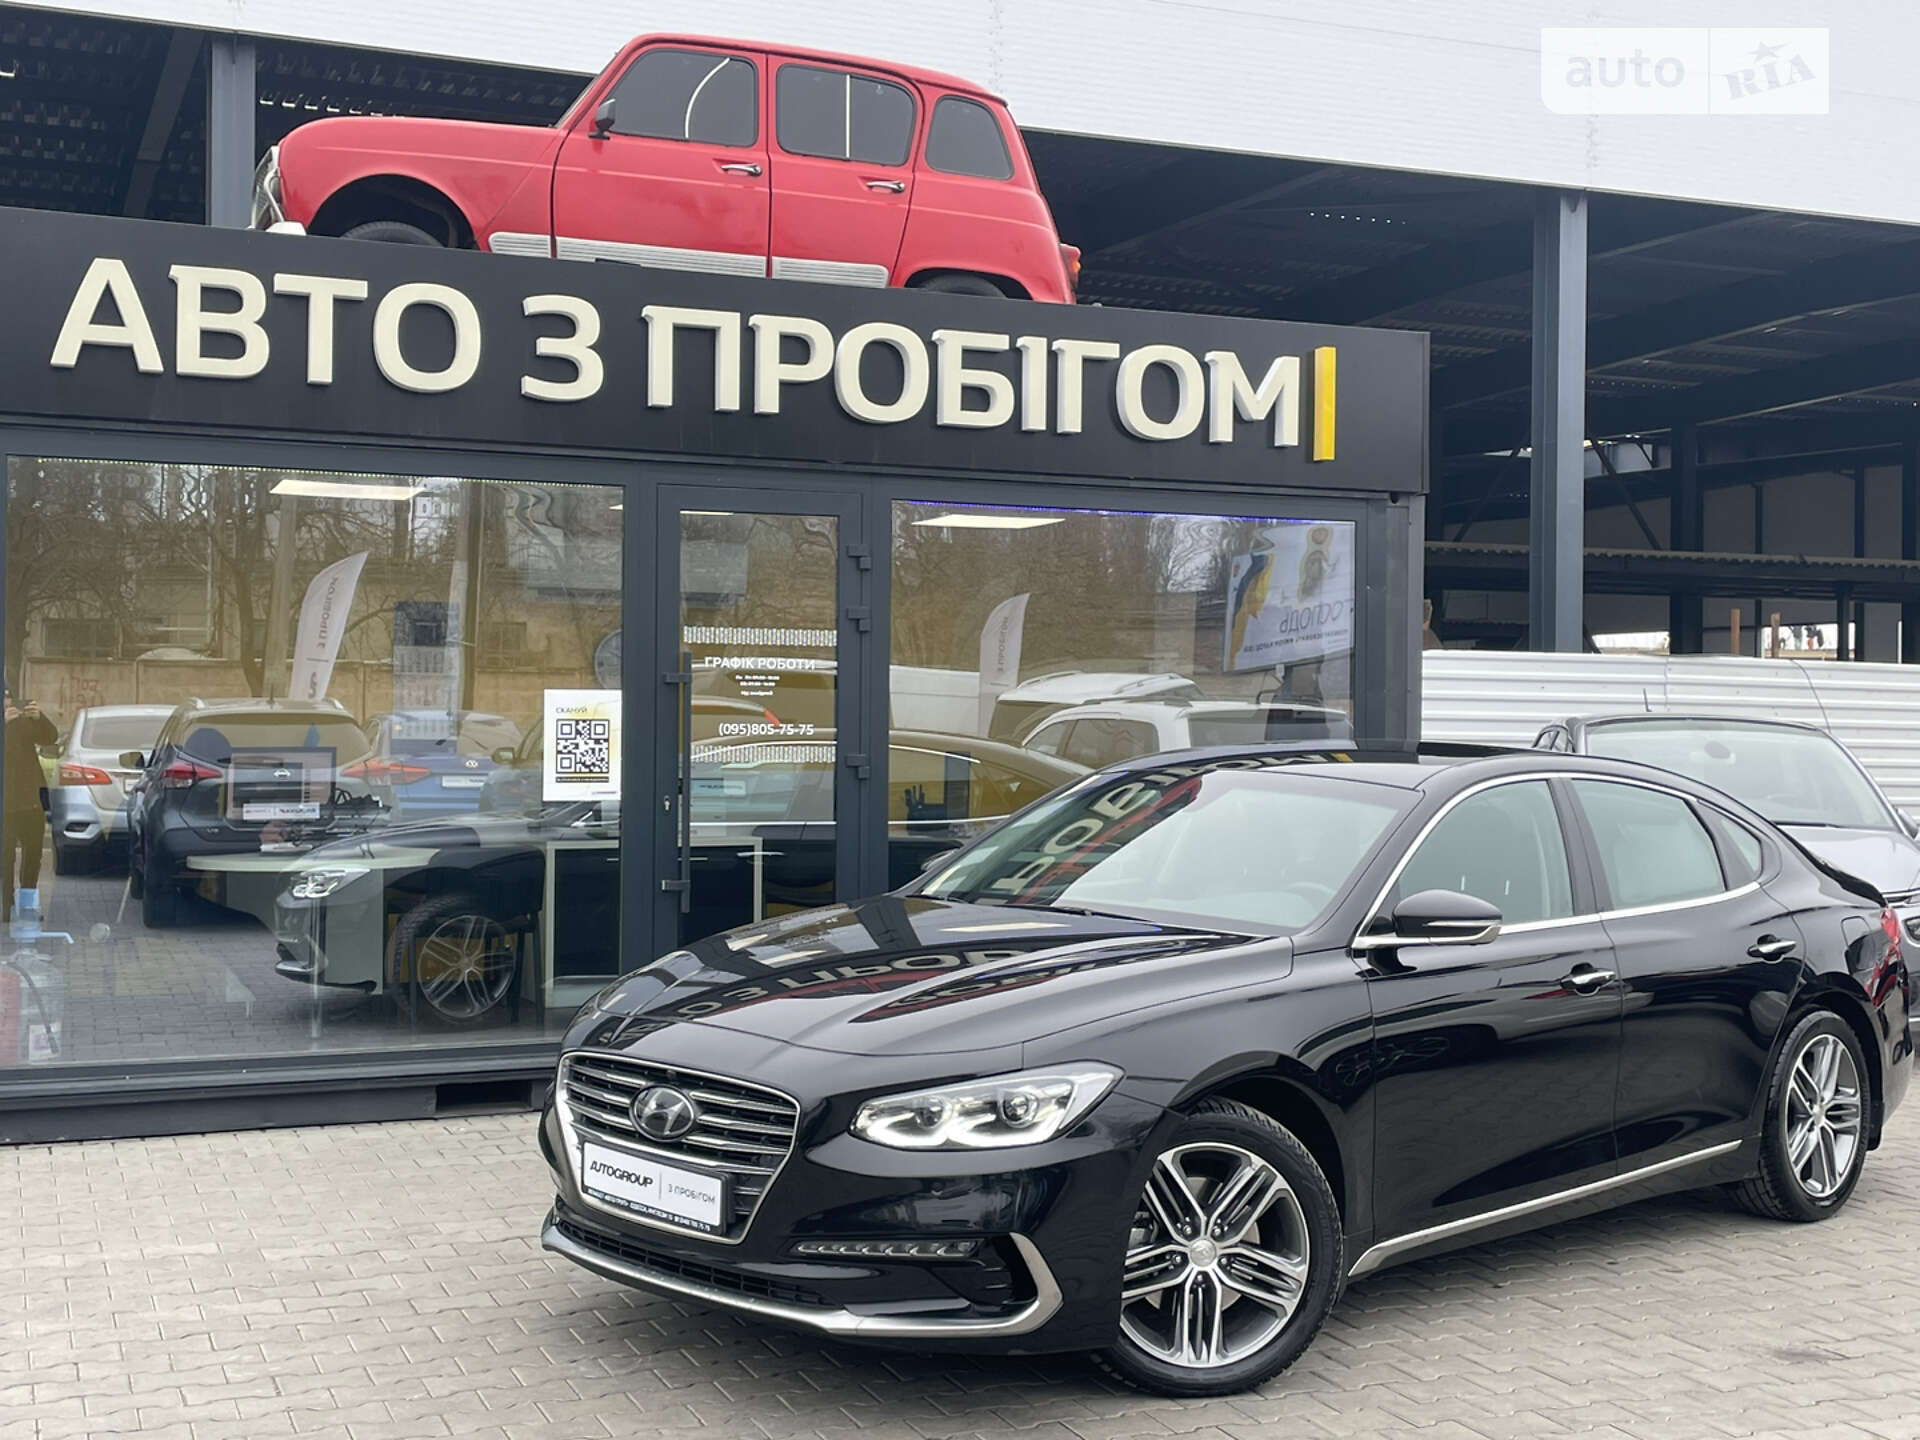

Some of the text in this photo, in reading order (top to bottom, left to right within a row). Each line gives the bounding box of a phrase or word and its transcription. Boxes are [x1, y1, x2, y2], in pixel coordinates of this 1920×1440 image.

[50, 257, 1300, 448] АВТО З ПРОБІГОМ
[704, 656, 816, 671] ГРАФІК РОБОТИ
[718, 723, 815, 737] (095)805-75-75
[589, 1160, 654, 1189] AUTOGROUP
